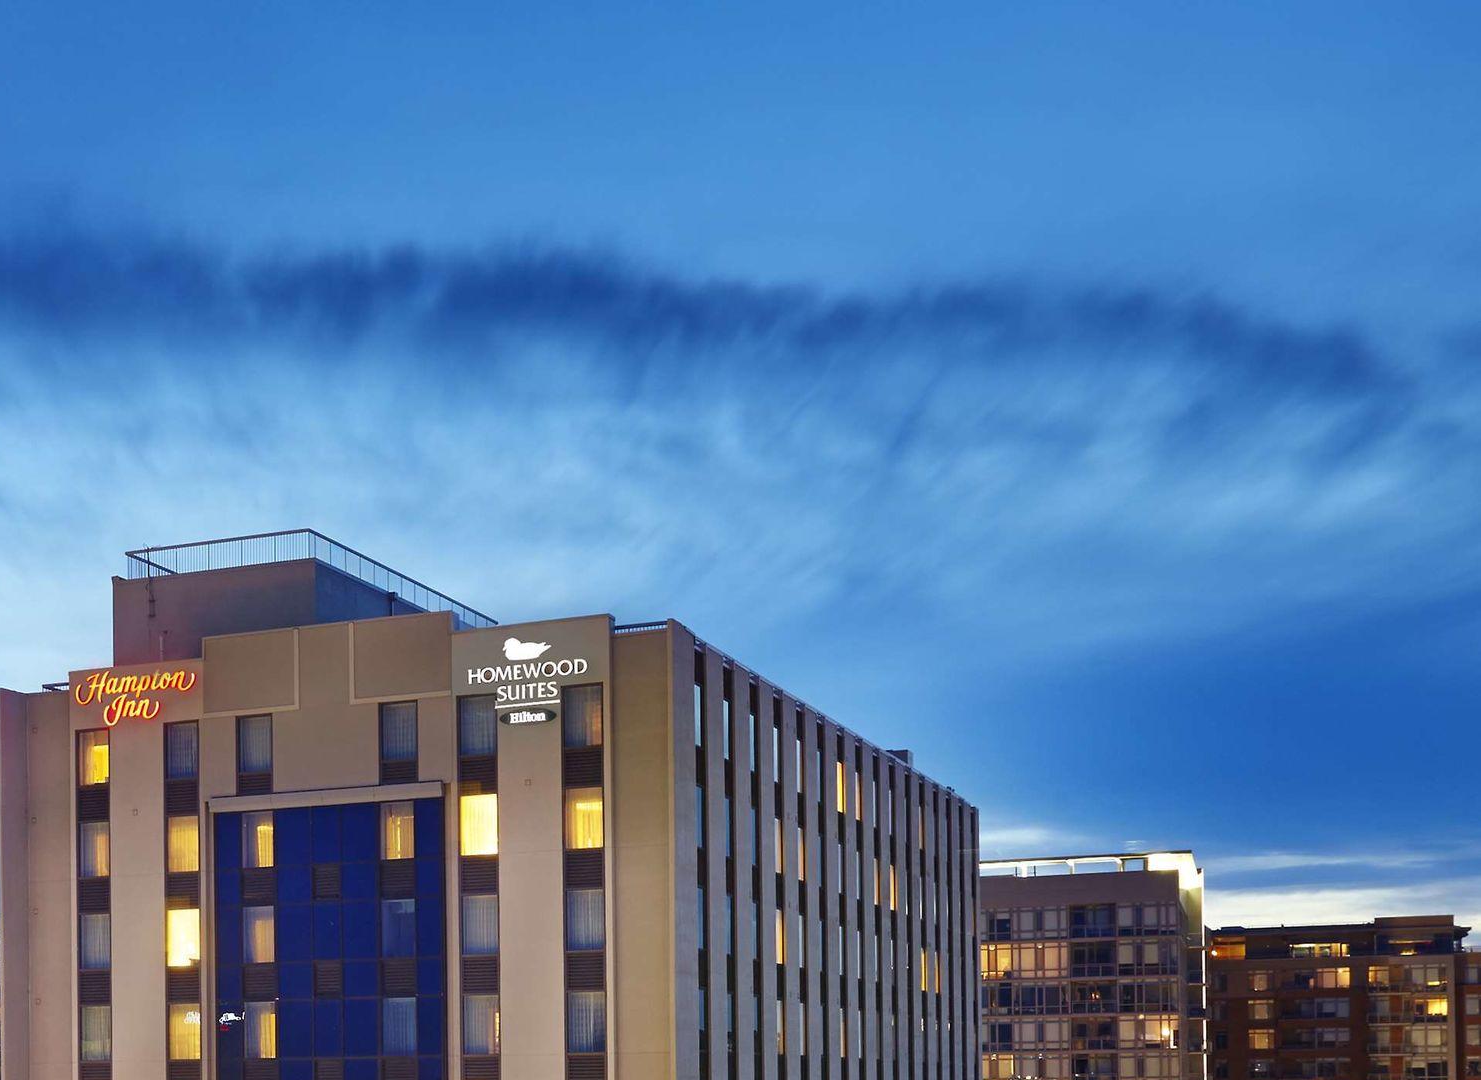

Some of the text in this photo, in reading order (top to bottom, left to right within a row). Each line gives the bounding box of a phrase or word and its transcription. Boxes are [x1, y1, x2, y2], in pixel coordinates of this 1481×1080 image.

[467, 659, 588, 684] HOMEWOOD
[75, 669, 196, 705] Hampton
[496, 682, 559, 702] SUITES
[103, 694, 160, 726] Inn
[509, 711, 547, 724] Hilton
